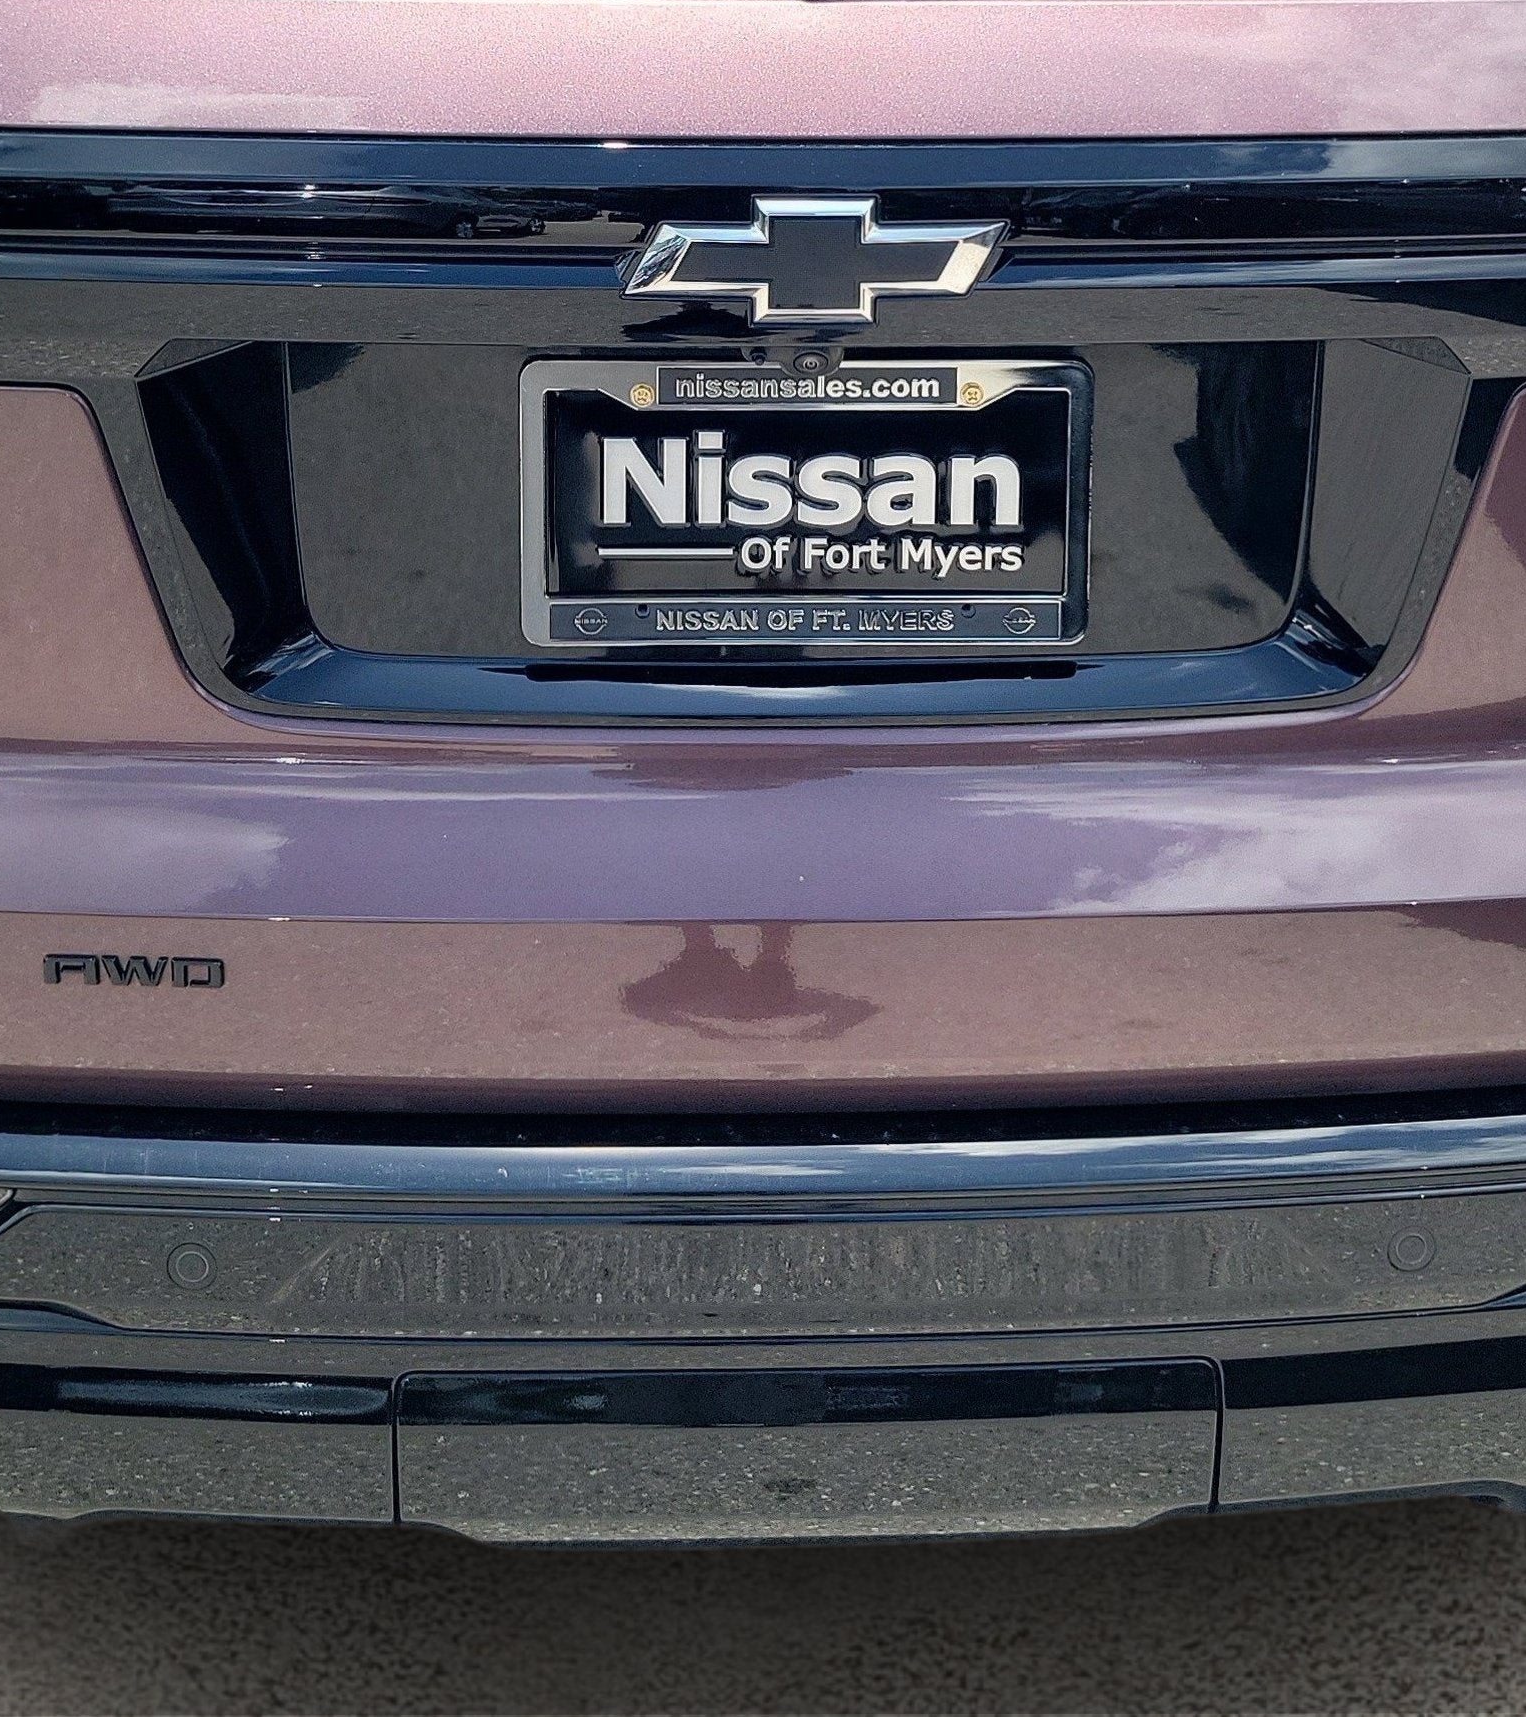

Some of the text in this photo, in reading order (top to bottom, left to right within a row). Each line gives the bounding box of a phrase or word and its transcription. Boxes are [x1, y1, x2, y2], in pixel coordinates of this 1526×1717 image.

[674, 372, 940, 399] nissansales.com
[601, 430, 1022, 527] Nissan
[740, 536, 1023, 579] Of Fort Myers
[655, 608, 955, 631] NISSAN OF FT. MYERS
[43, 953, 226, 990] AWD
